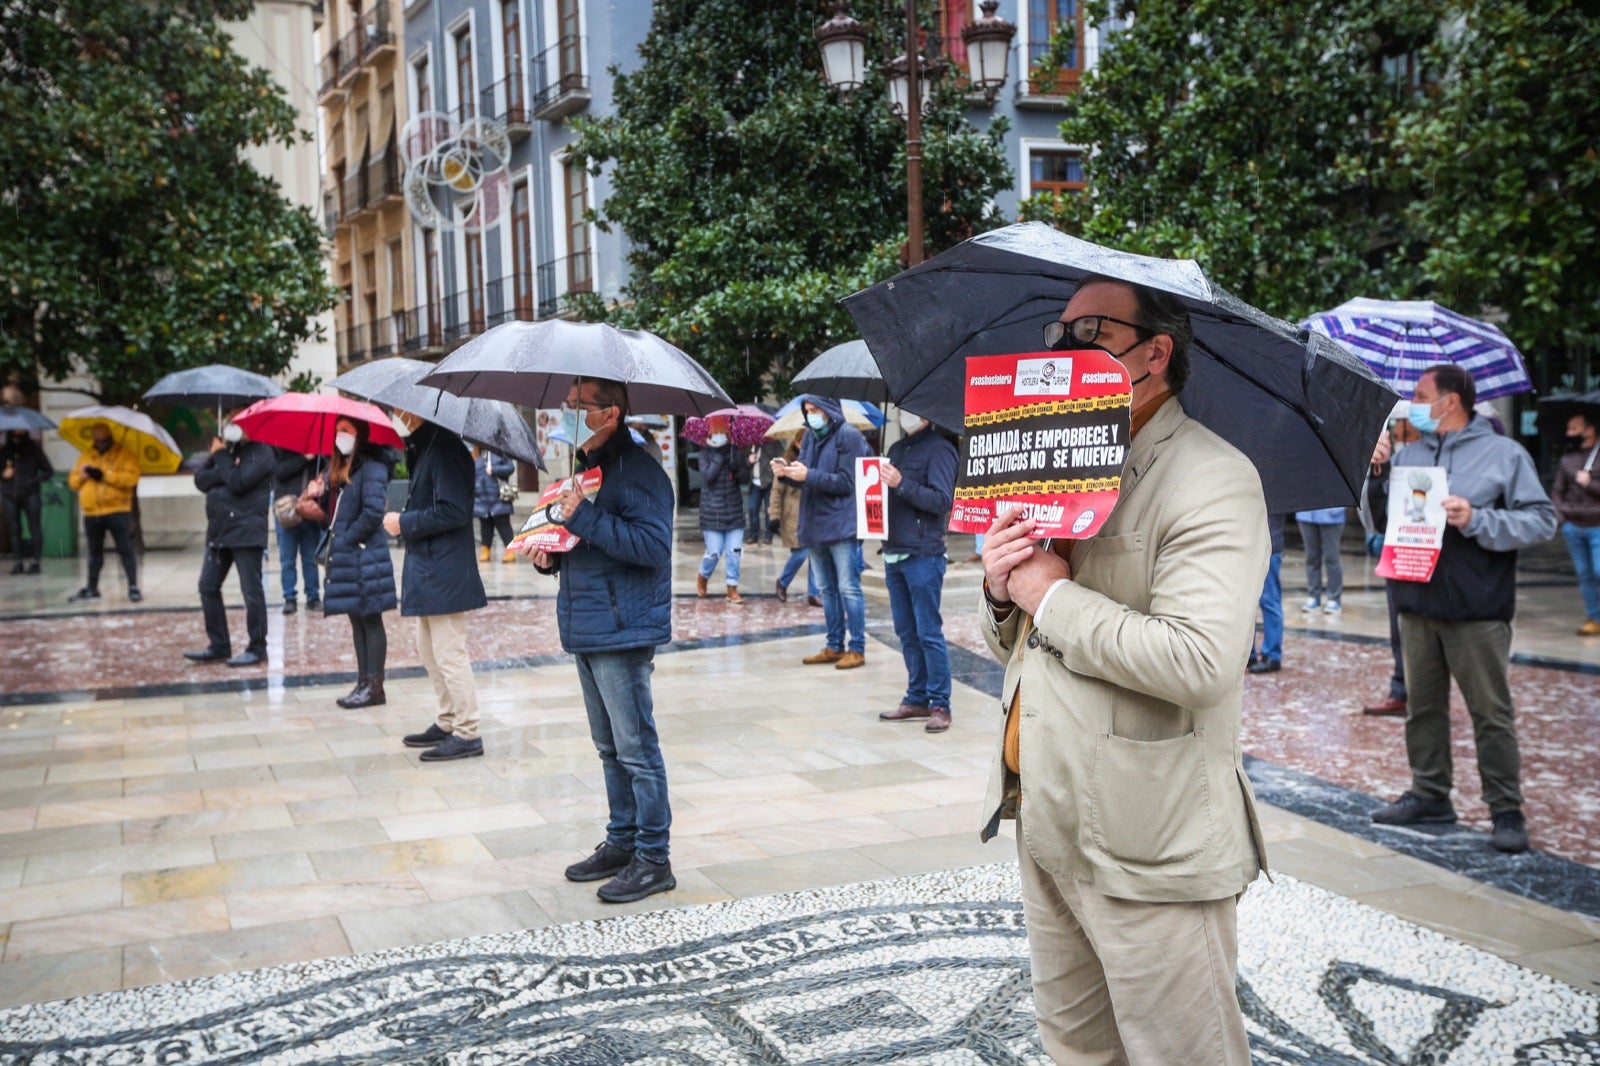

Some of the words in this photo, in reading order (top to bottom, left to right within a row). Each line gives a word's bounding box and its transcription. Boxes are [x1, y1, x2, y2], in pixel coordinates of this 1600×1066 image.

[1081, 371, 1123, 384] #sosturismo
[970, 428, 1020, 458] GRANADA
[1021, 431, 1032, 450] SE
[1035, 424, 1108, 449] EMPOBRECE
[1111, 424, 1119, 444] Y
[966, 458, 986, 476] LOS
[1030, 450, 1046, 470] NO
[1053, 448, 1069, 468] SE
[1072, 444, 1124, 468] MUEVEN
[557, 928, 836, 988] NOMBRADA
